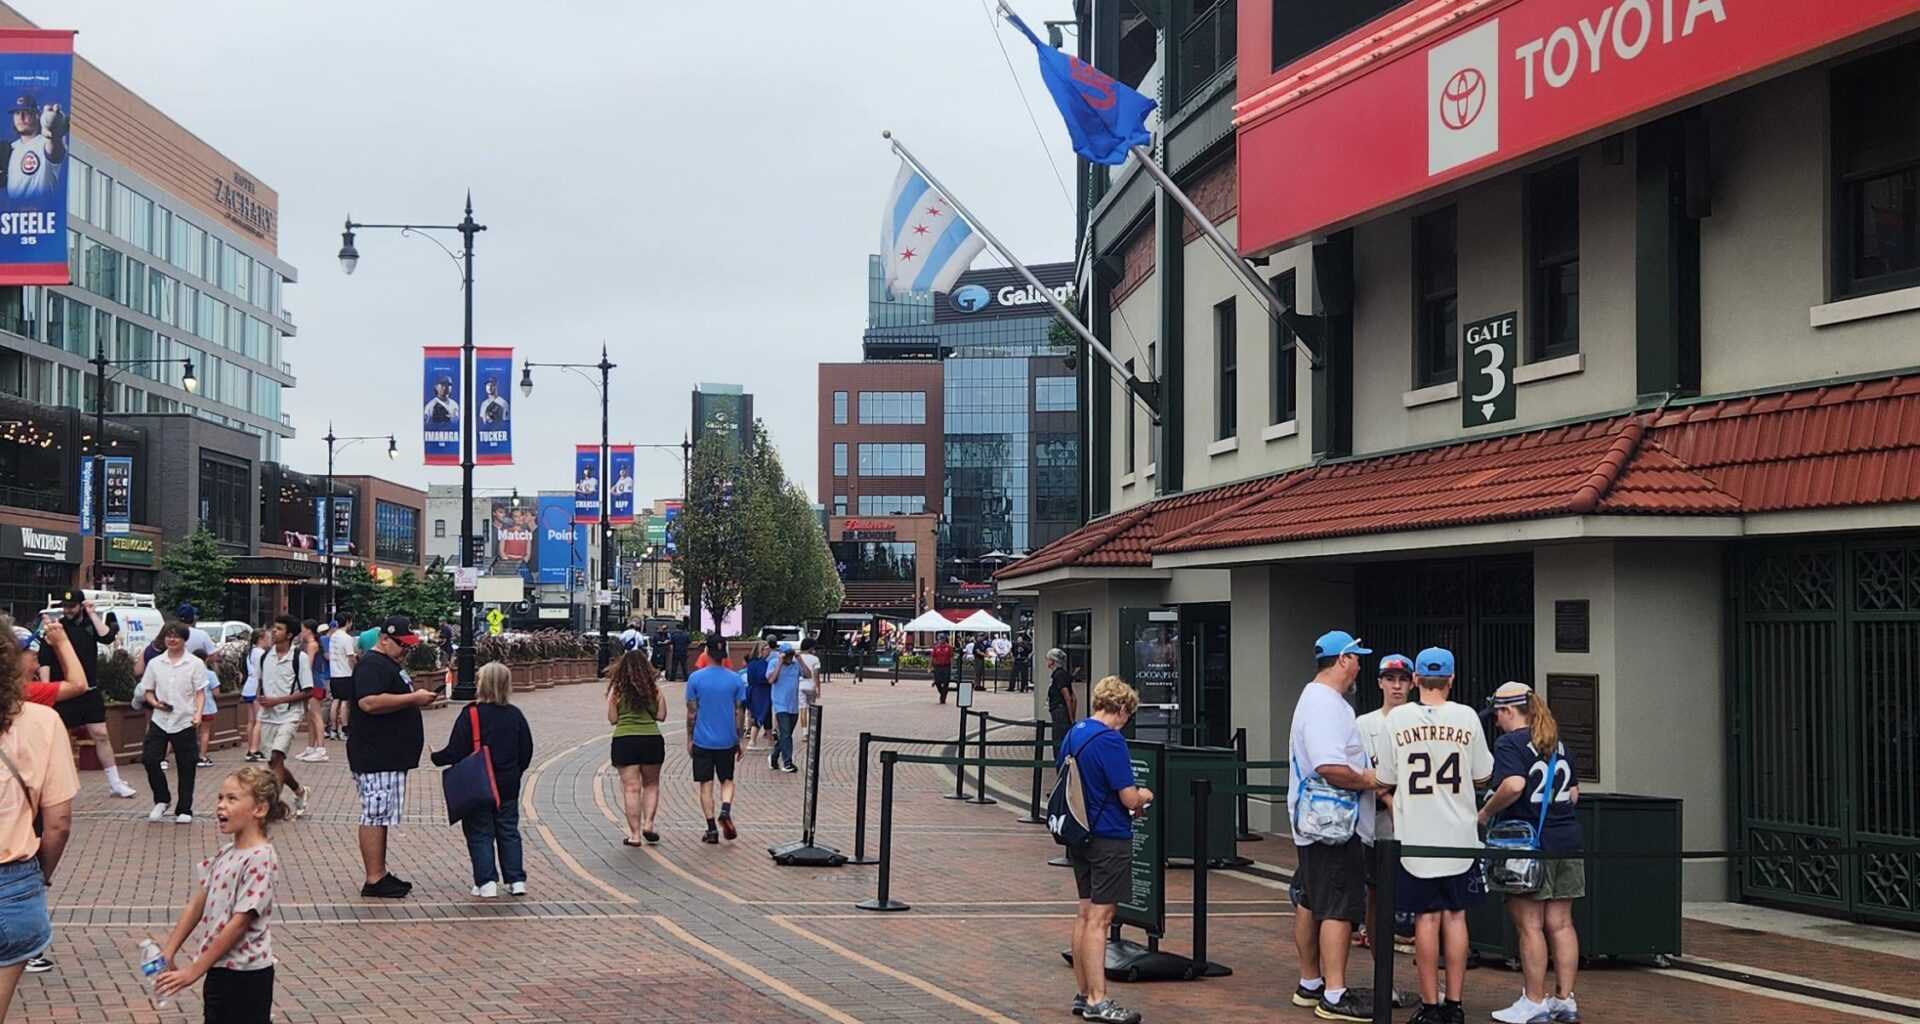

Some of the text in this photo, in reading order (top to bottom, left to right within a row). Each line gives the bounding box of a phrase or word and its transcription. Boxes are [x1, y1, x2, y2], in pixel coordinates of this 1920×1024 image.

[1515, 0, 1727, 99] TOYOTA
[214, 177, 273, 233] ZACHARY
[0, 211, 56, 235] STEELE
[20, 236, 37, 245] 35
[1466, 318, 1513, 344] GATE
[1471, 342, 1506, 402] 3
[479, 430, 508, 442] TUCKER
[497, 529, 533, 541] Match
[548, 529, 578, 541] Point
[842, 530, 897, 541] BRICKHOUSE
[844, 518, 896, 530] Budweiser
[1395, 725, 1472, 747] CONTRERAS
[1407, 752, 1462, 795] 24
[1528, 759, 1572, 805] 22
